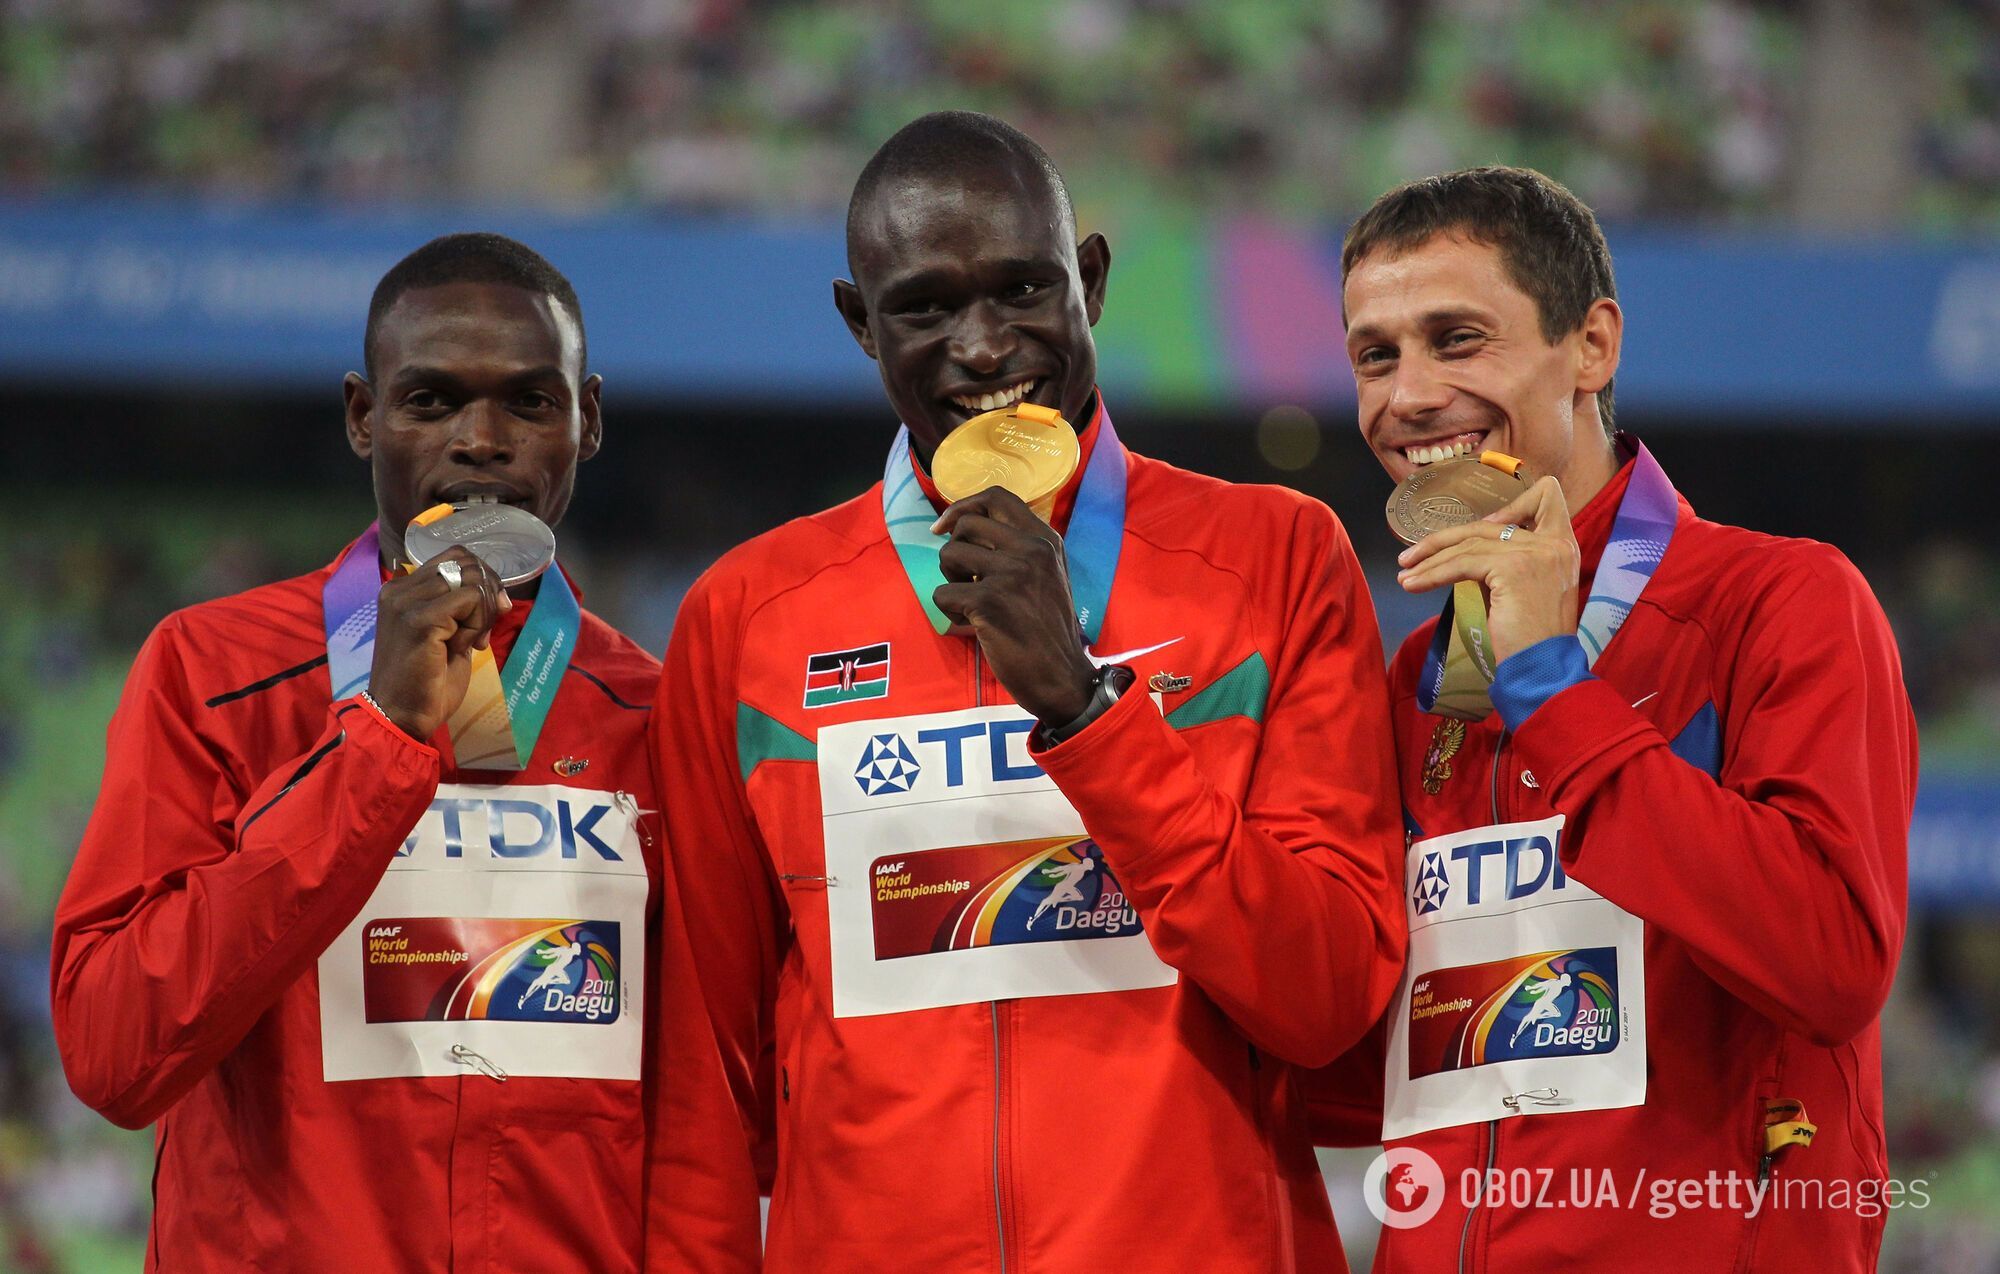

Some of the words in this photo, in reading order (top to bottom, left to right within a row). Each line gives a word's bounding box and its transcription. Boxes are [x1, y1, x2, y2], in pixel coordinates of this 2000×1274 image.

[526, 686, 542, 705] for
[537, 627, 566, 686] tomorrow
[505, 688, 521, 721] print
[515, 637, 544, 689] together
[918, 719, 1047, 787] TD
[428, 798, 624, 861] TDK
[875, 862, 905, 875] IAAF
[876, 872, 912, 889] World
[877, 879, 970, 901] Championships
[1055, 906, 1137, 933] Daegu
[369, 926, 402, 937] IAAF
[369, 938, 409, 951] World
[369, 949, 469, 965] Championships
[583, 979, 614, 995] 2011
[1414, 980, 1431, 994] IAAF
[543, 988, 614, 1020] Daegu
[1412, 997, 1473, 1020] Championships
[1413, 991, 1434, 1008] World
[1576, 1007, 1612, 1025] 2011
[1534, 1022, 1612, 1050] Daegu
